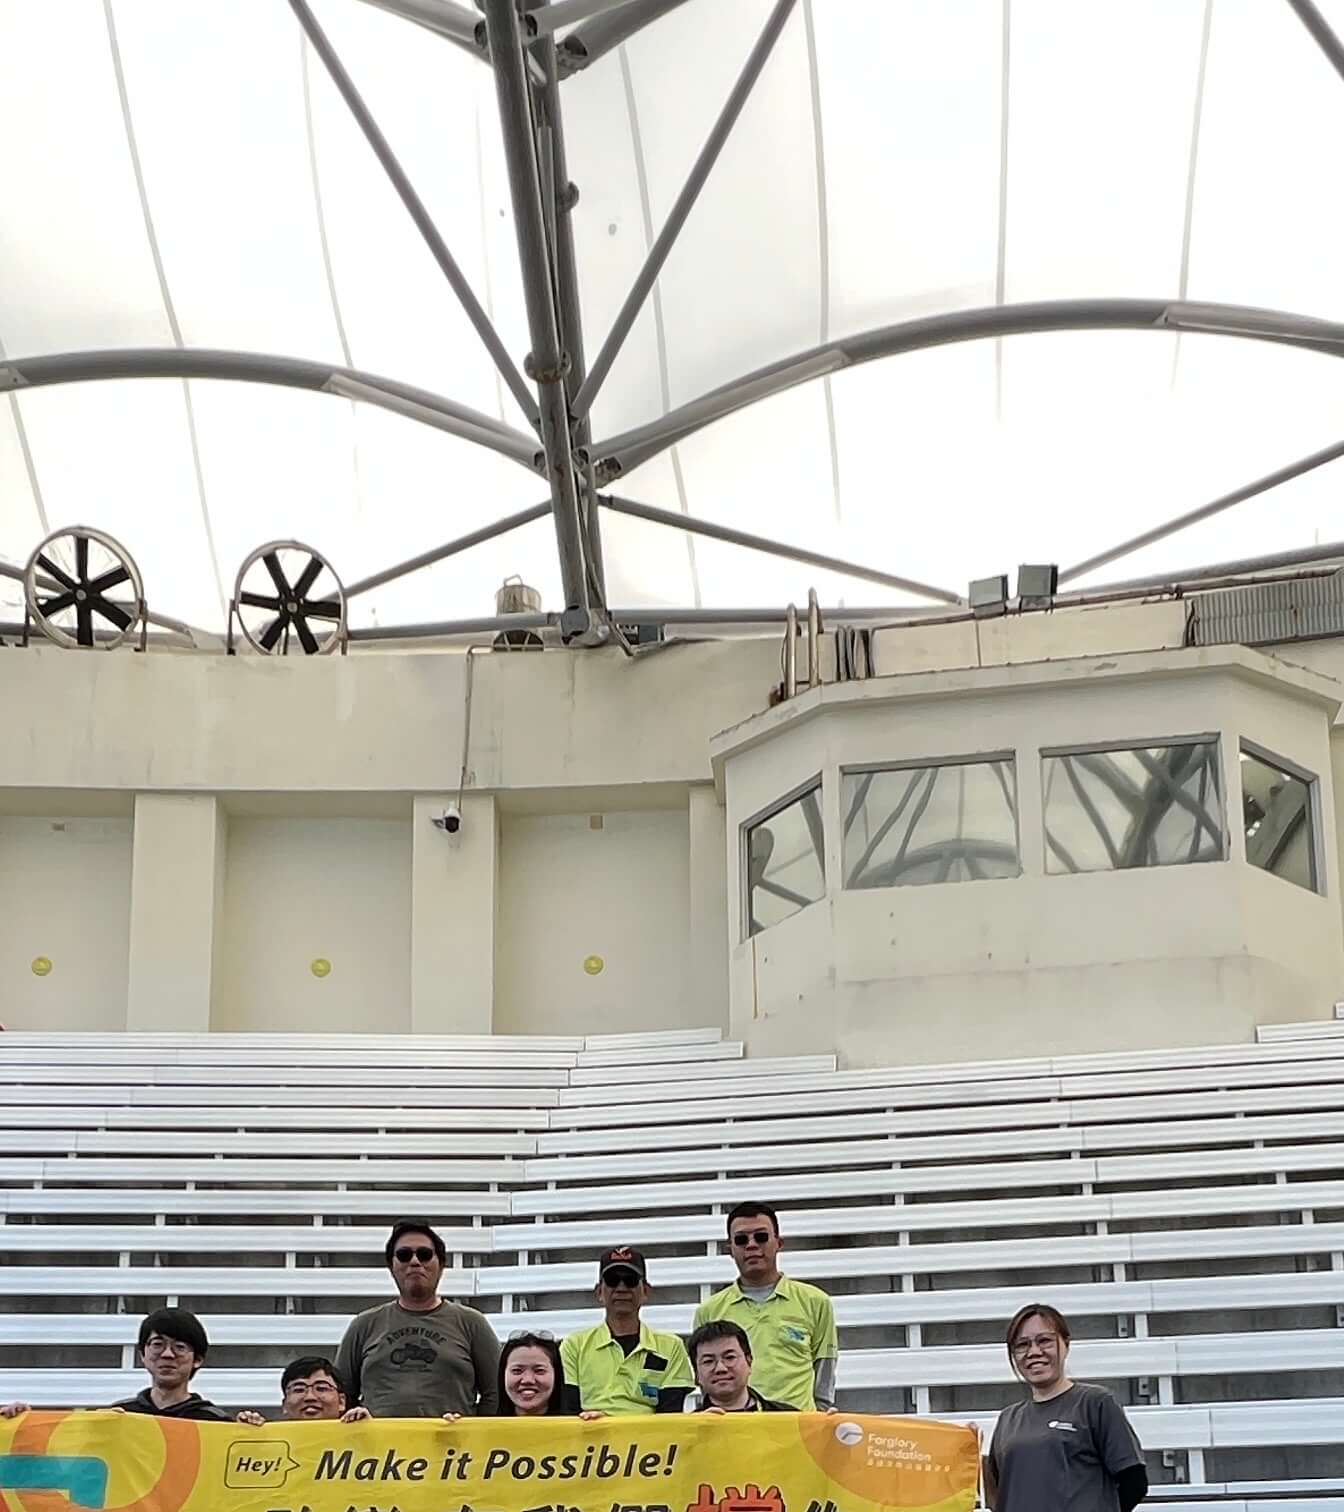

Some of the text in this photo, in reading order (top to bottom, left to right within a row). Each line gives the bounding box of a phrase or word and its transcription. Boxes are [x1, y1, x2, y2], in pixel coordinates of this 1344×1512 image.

[868, 1433, 918, 1449] Farglory
[314, 1444, 678, 1481] Make it Possible!
[867, 1446, 932, 1462] Foundation
[235, 1456, 283, 1477] Hey!
